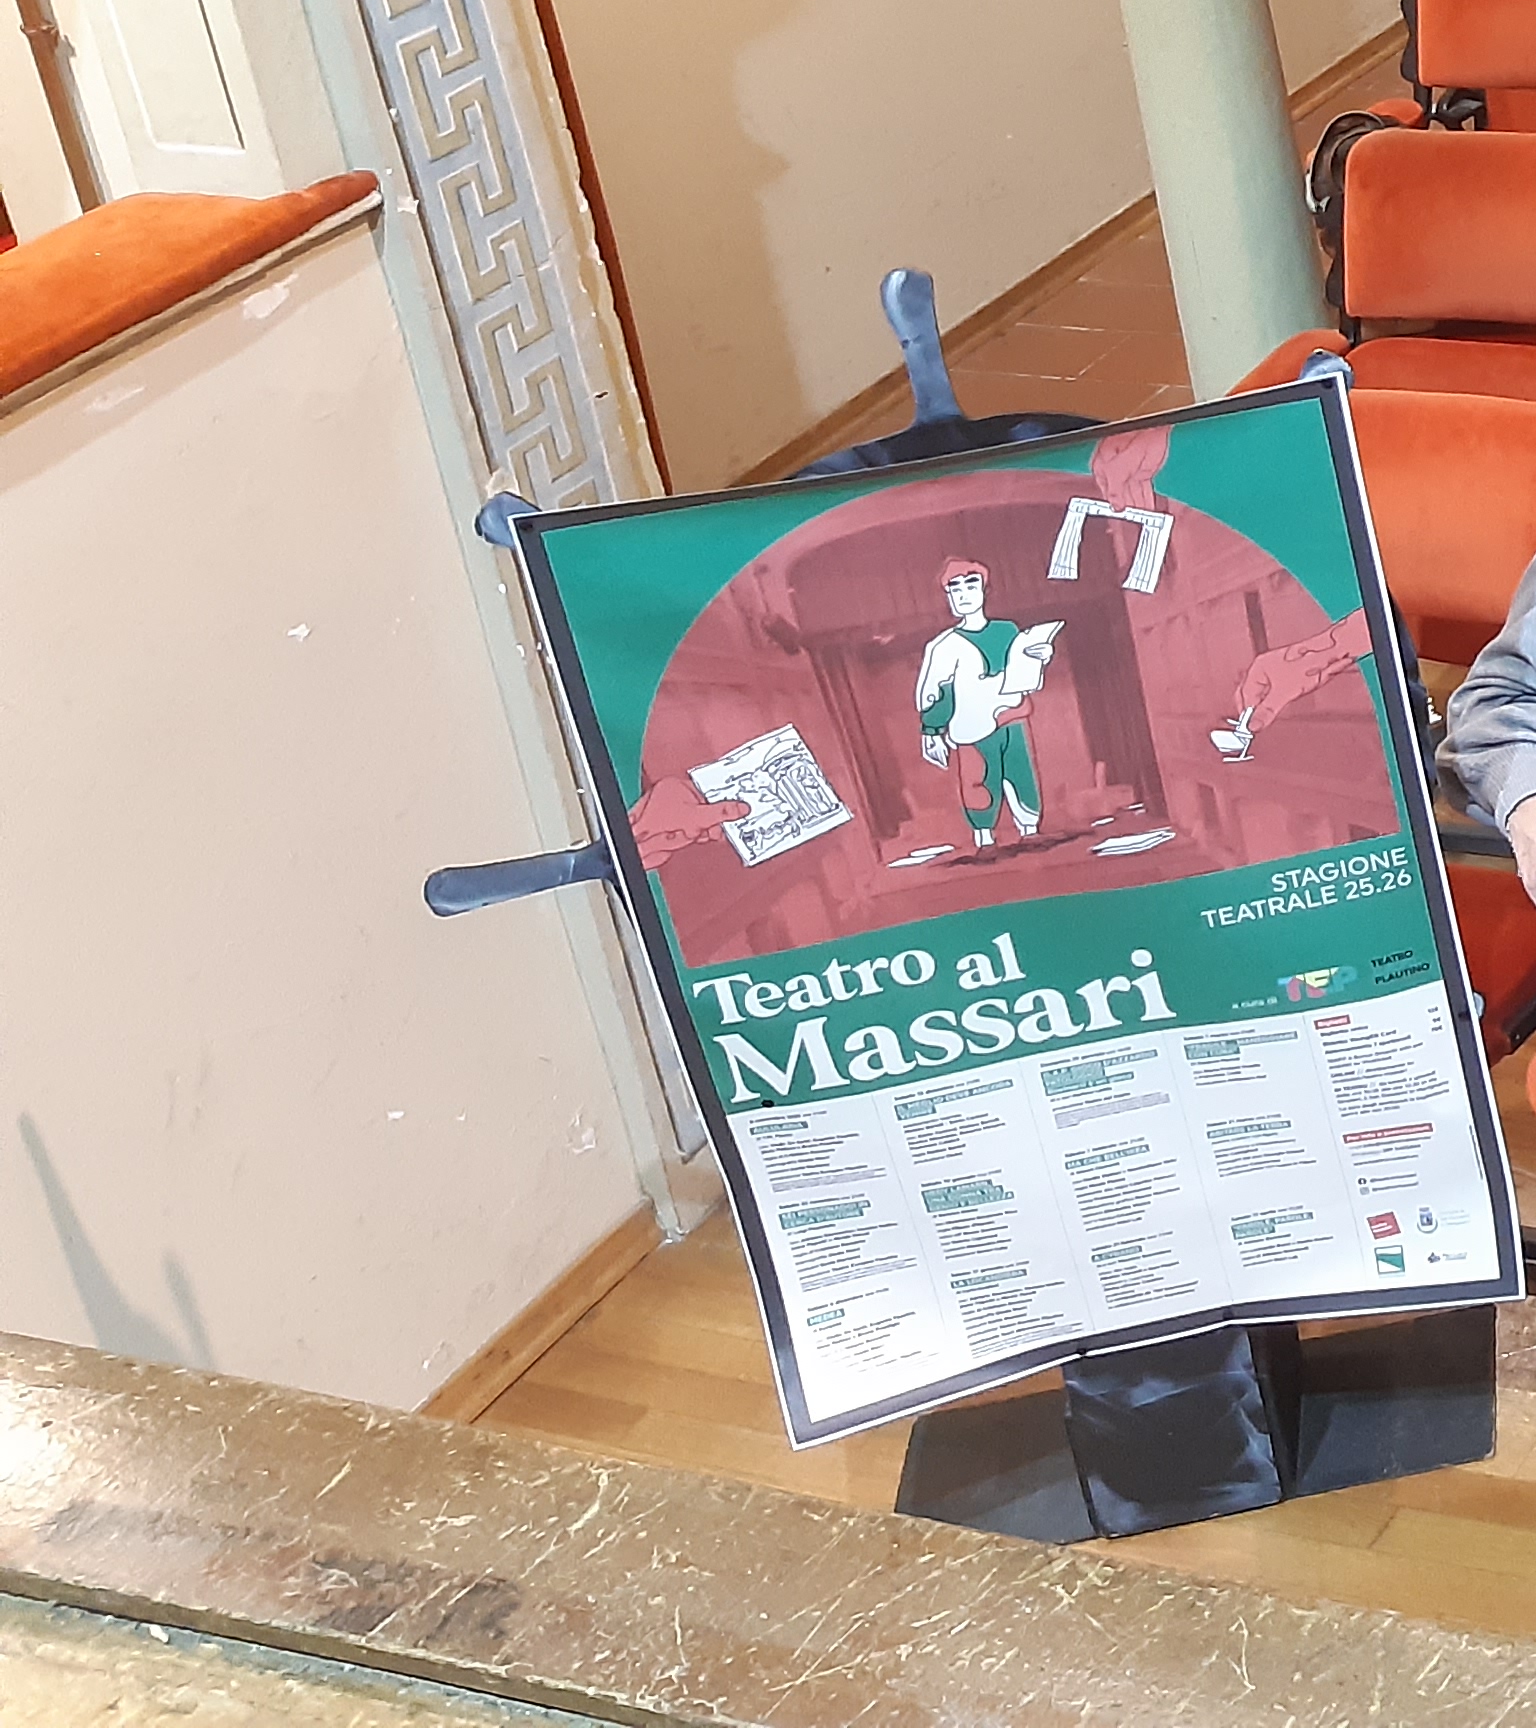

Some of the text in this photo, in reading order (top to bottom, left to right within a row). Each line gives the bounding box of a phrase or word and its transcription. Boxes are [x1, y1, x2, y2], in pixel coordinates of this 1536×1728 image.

[1271, 846, 1409, 893] STAGIONE
[1200, 869, 1412, 929] TEATRALE 25.26
[693, 932, 1026, 1026] Teatro al
[1375, 962, 1431, 985] PLAUTINO
[1240, 998, 1264, 1009] cura
[1266, 995, 1279, 1006] di
[712, 948, 1177, 1105] Massari
[808, 1309, 844, 1325] MEDEA
